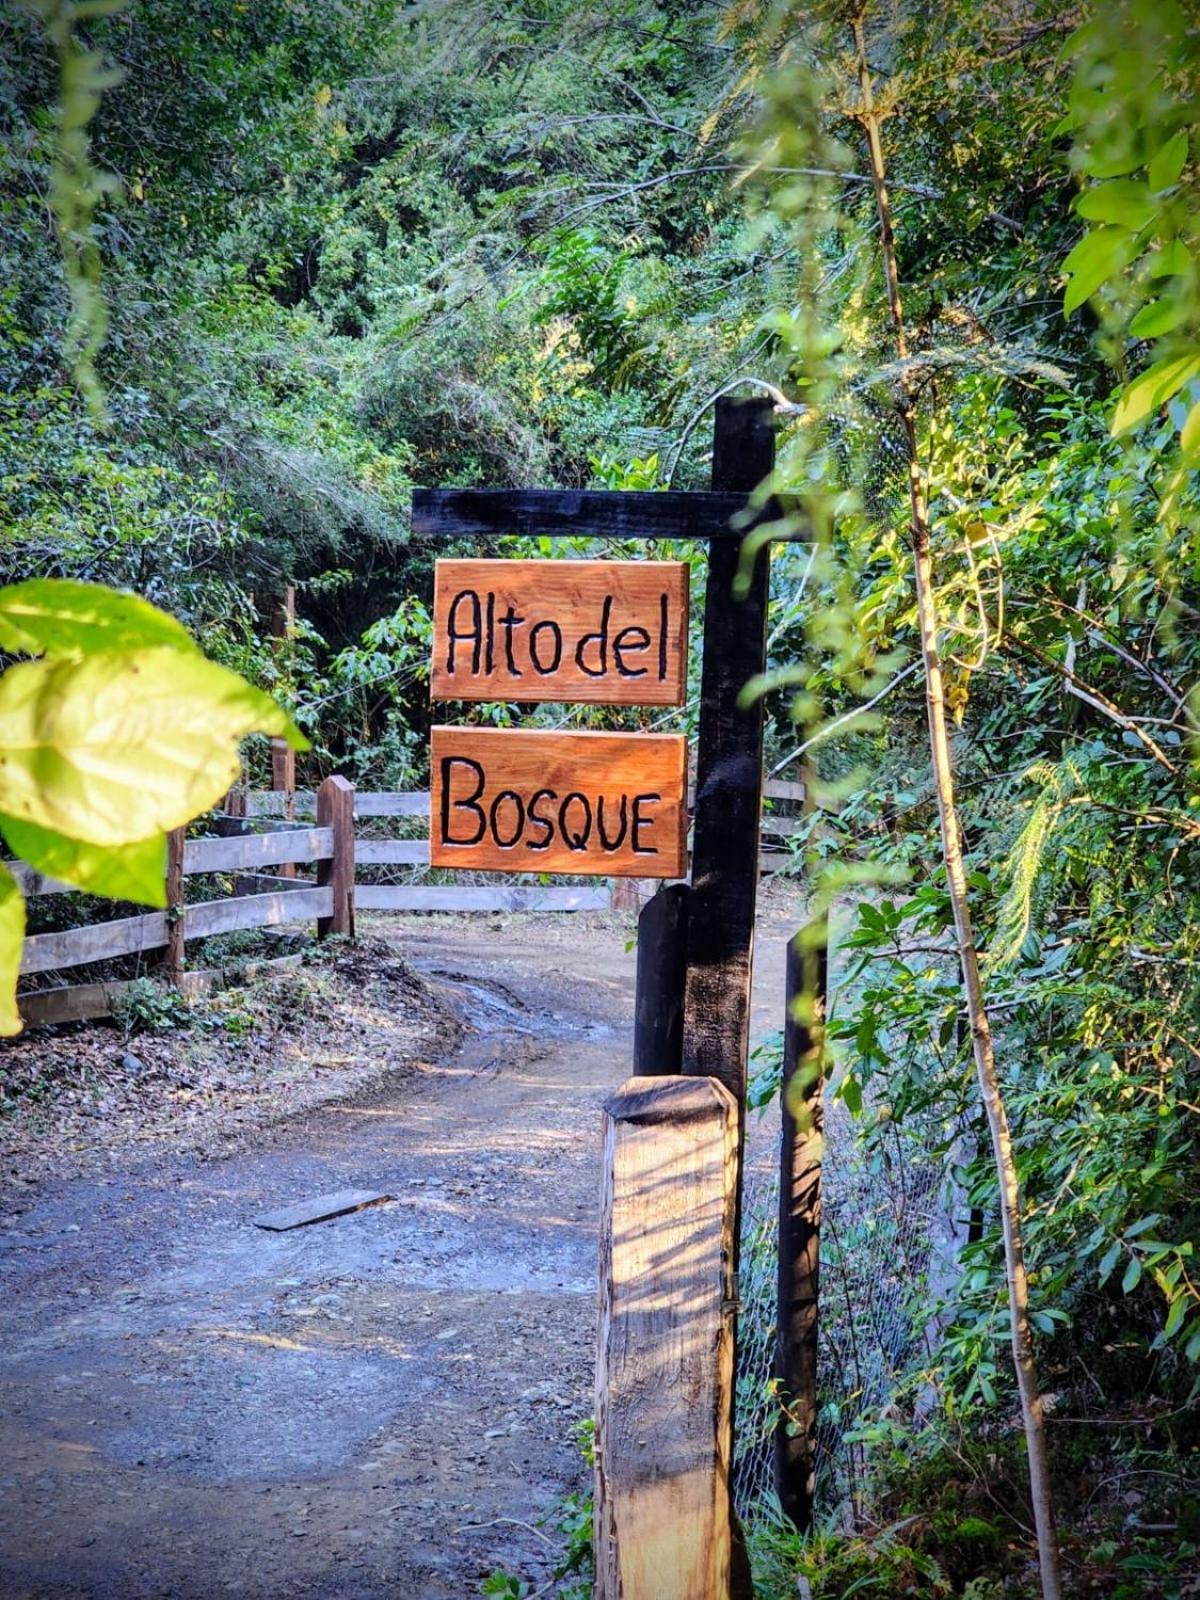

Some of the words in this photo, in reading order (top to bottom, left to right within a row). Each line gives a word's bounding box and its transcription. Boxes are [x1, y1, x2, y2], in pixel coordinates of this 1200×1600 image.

[447, 590, 562, 675] Alto
[575, 594, 668, 680] del
[441, 756, 661, 853] BOSQUE
